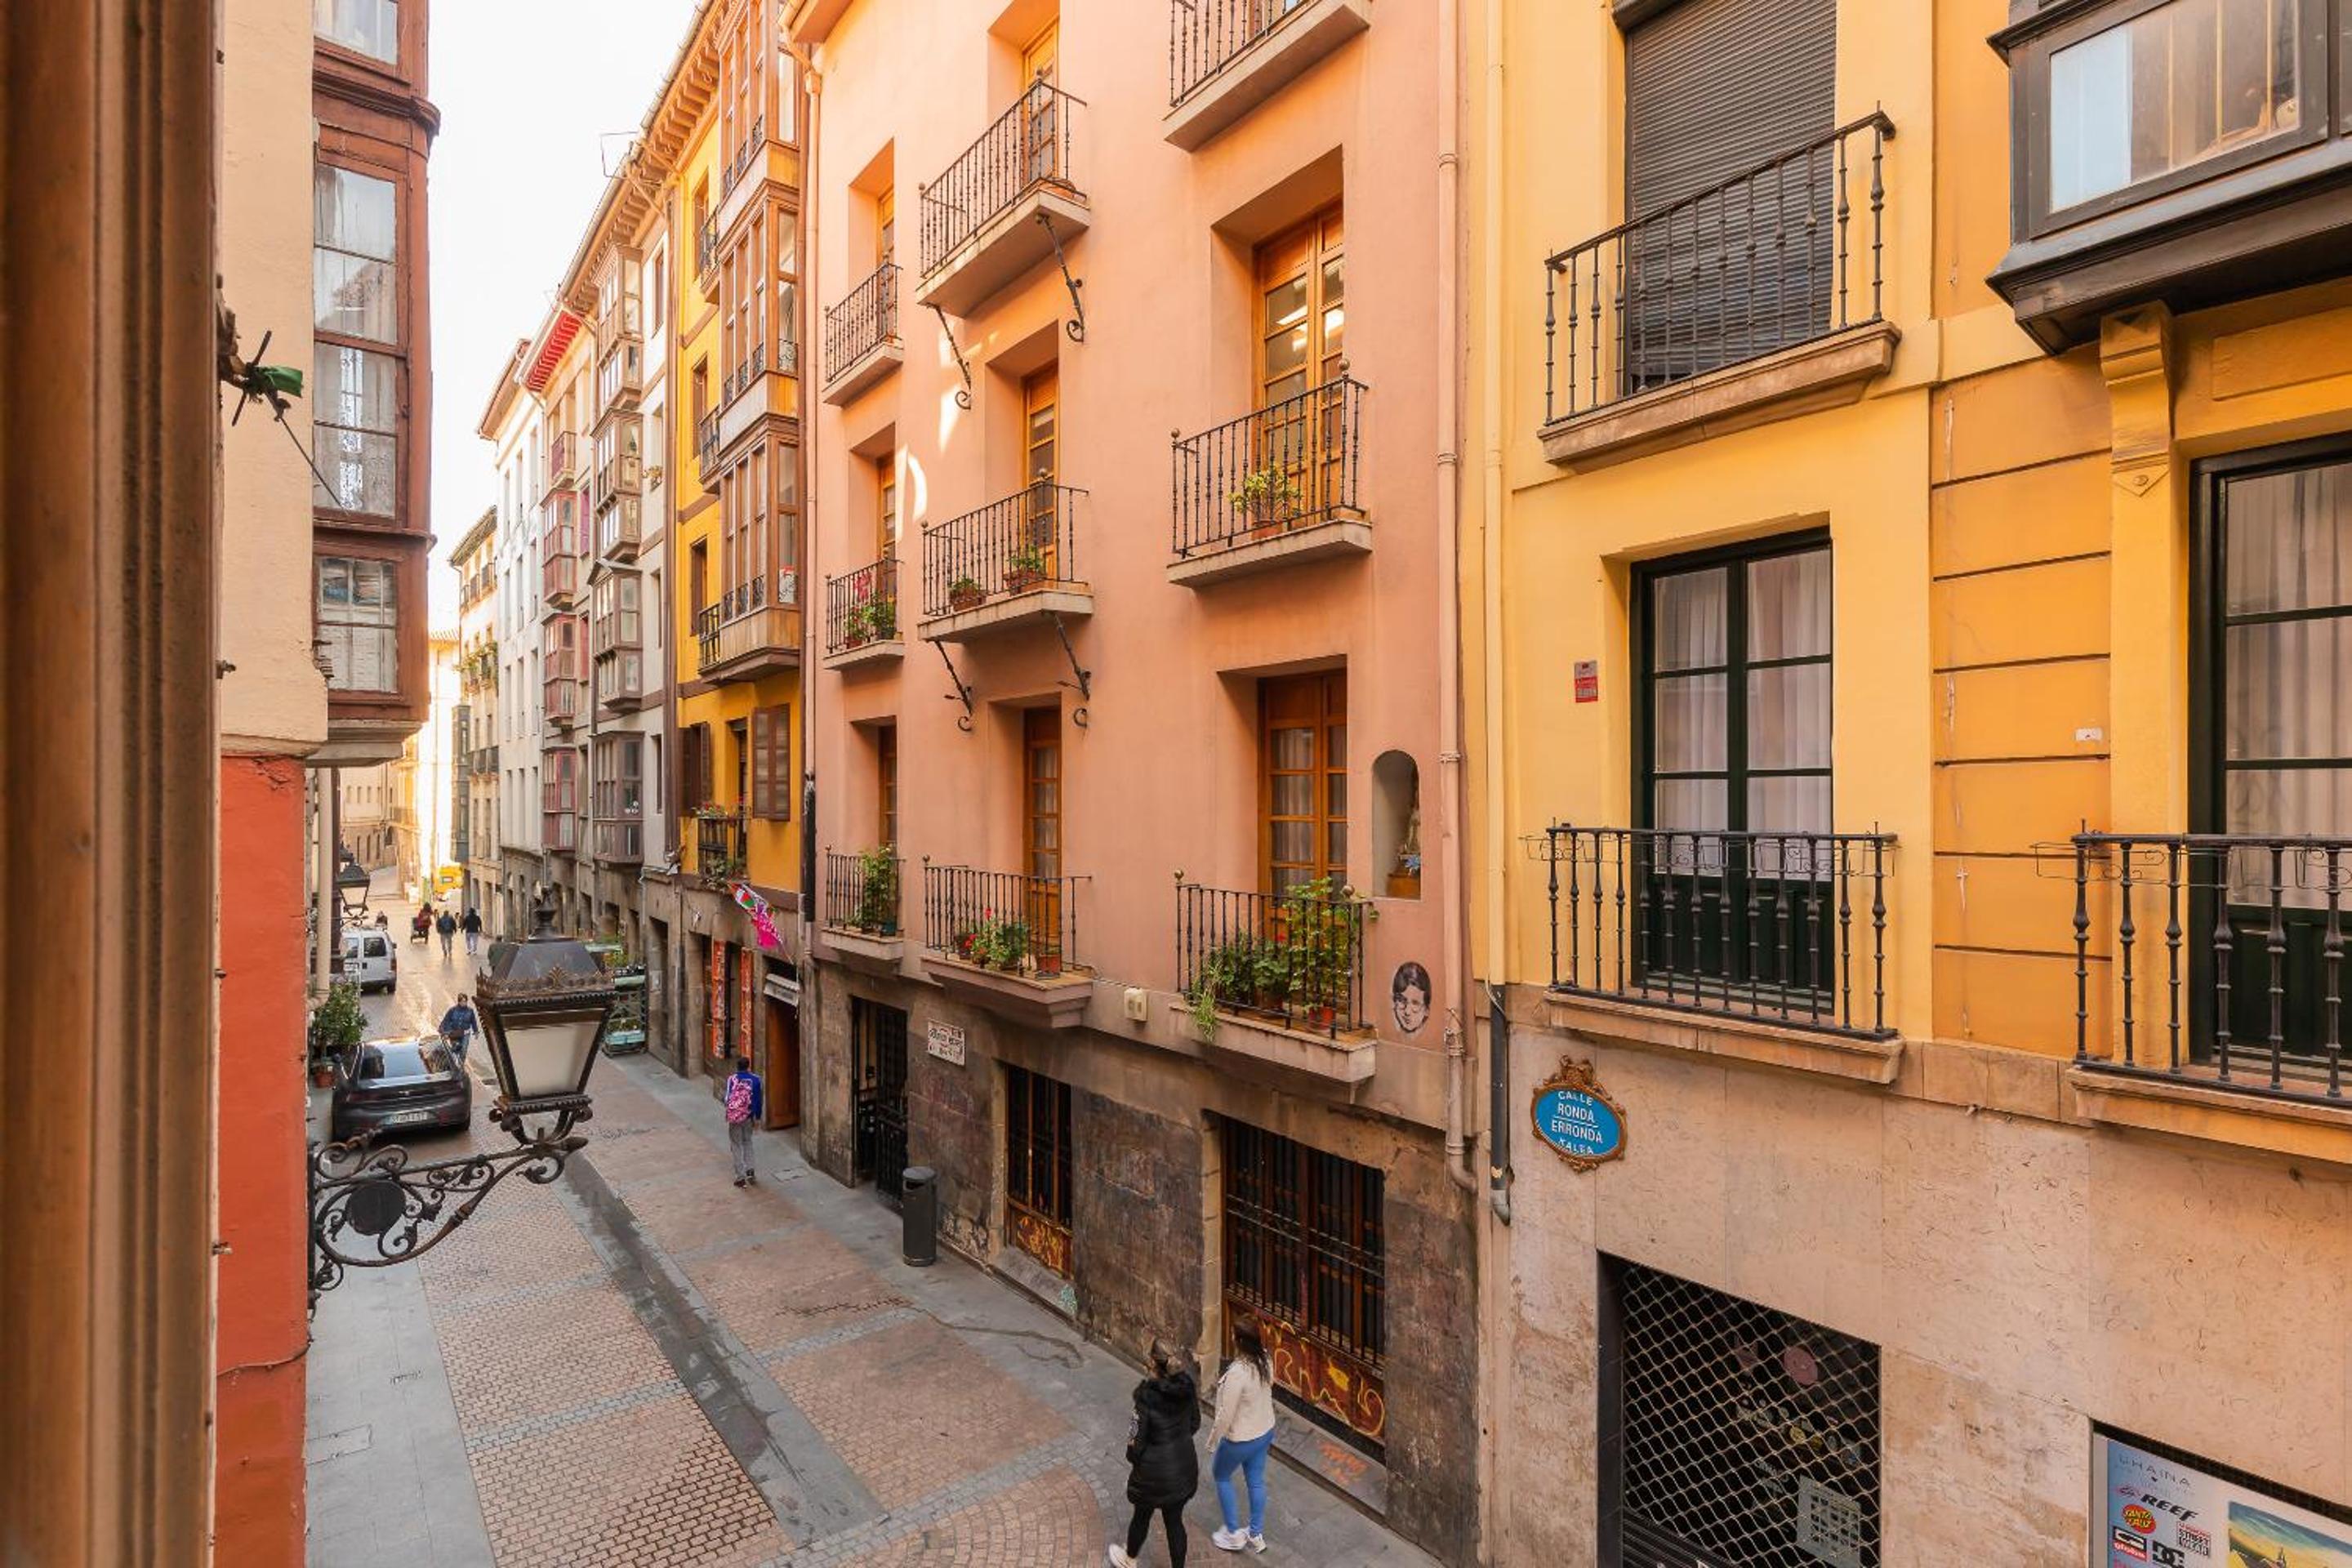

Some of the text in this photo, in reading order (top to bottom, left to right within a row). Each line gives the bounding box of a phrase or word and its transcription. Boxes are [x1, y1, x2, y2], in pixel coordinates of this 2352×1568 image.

[1557, 1090, 1593, 1107] CALLE
[1557, 1102, 1596, 1124] RONDA
[1552, 1120, 1603, 1144] ERRONDA
[2140, 1494, 2199, 1521] REEF
